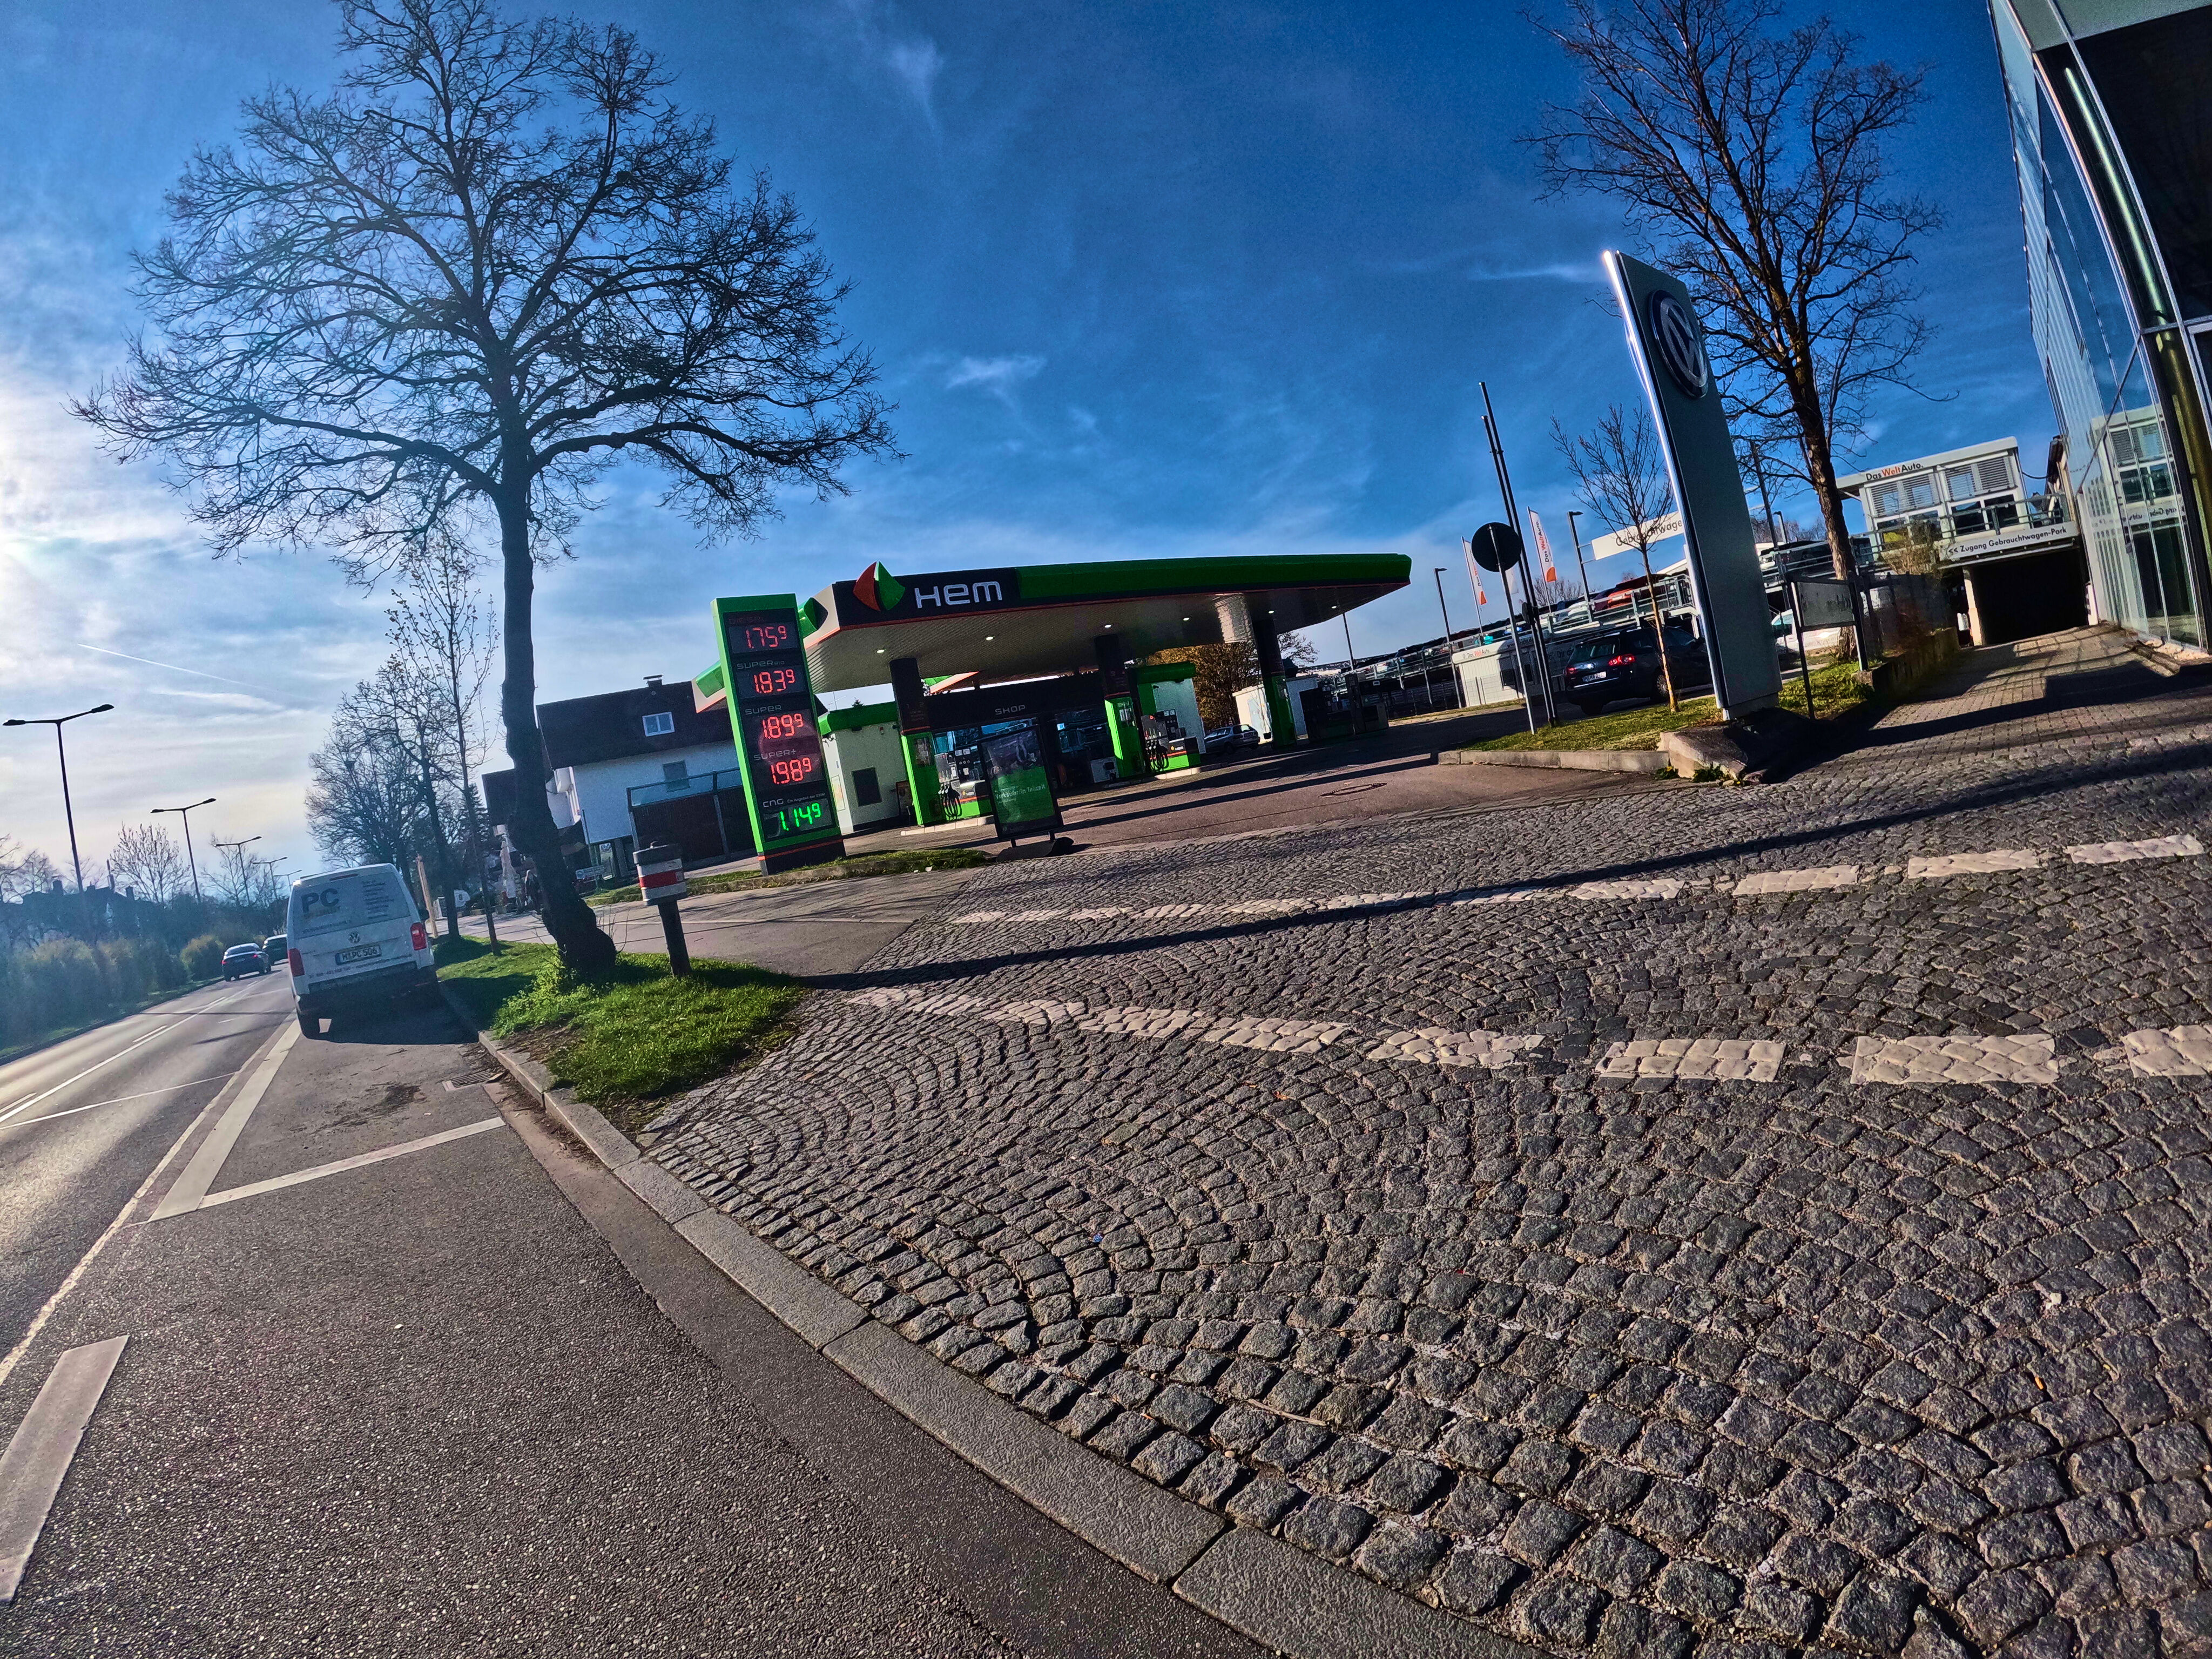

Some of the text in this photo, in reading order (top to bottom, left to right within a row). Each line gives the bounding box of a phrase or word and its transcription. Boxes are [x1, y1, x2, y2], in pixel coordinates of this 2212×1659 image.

[1960, 543, 1987, 552] Zugang
[1988, 527, 2067, 547] Gebrauchtwagen-Park
[995, 705, 1026, 715] SHOP
[301, 888, 340, 913] PC
